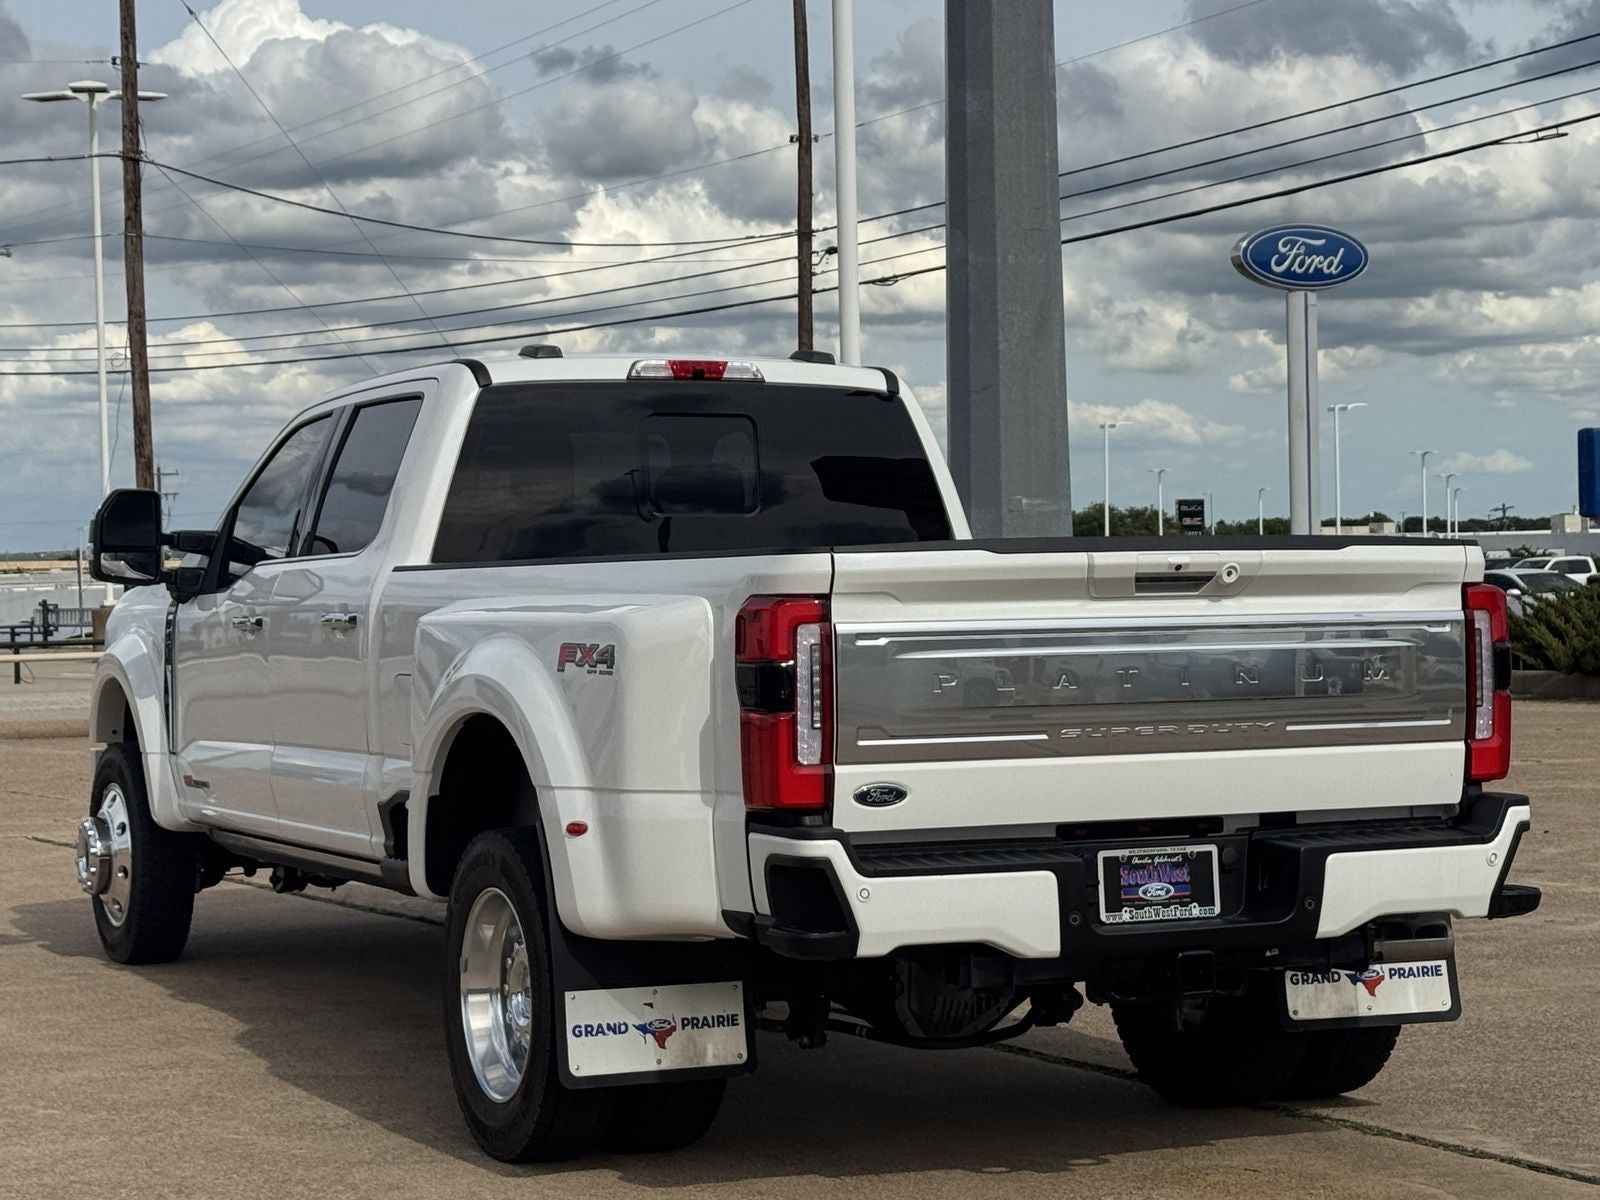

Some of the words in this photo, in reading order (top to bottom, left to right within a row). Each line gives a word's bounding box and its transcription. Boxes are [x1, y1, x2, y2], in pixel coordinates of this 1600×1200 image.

[1271, 235, 1344, 274] Ford
[557, 642, 615, 672] FX4
[933, 658, 1391, 693] PLATINUM
[1061, 724, 1178, 738] SUPER
[1187, 721, 1275, 733] DUTY
[866, 788, 896, 802] Ford
[1146, 885, 1166, 896] Ford
[1290, 971, 1341, 986] GRAND
[1388, 964, 1443, 980] PRAIRIE
[571, 1021, 629, 1038] GRAND
[681, 1013, 740, 1030] PRAIRIE
